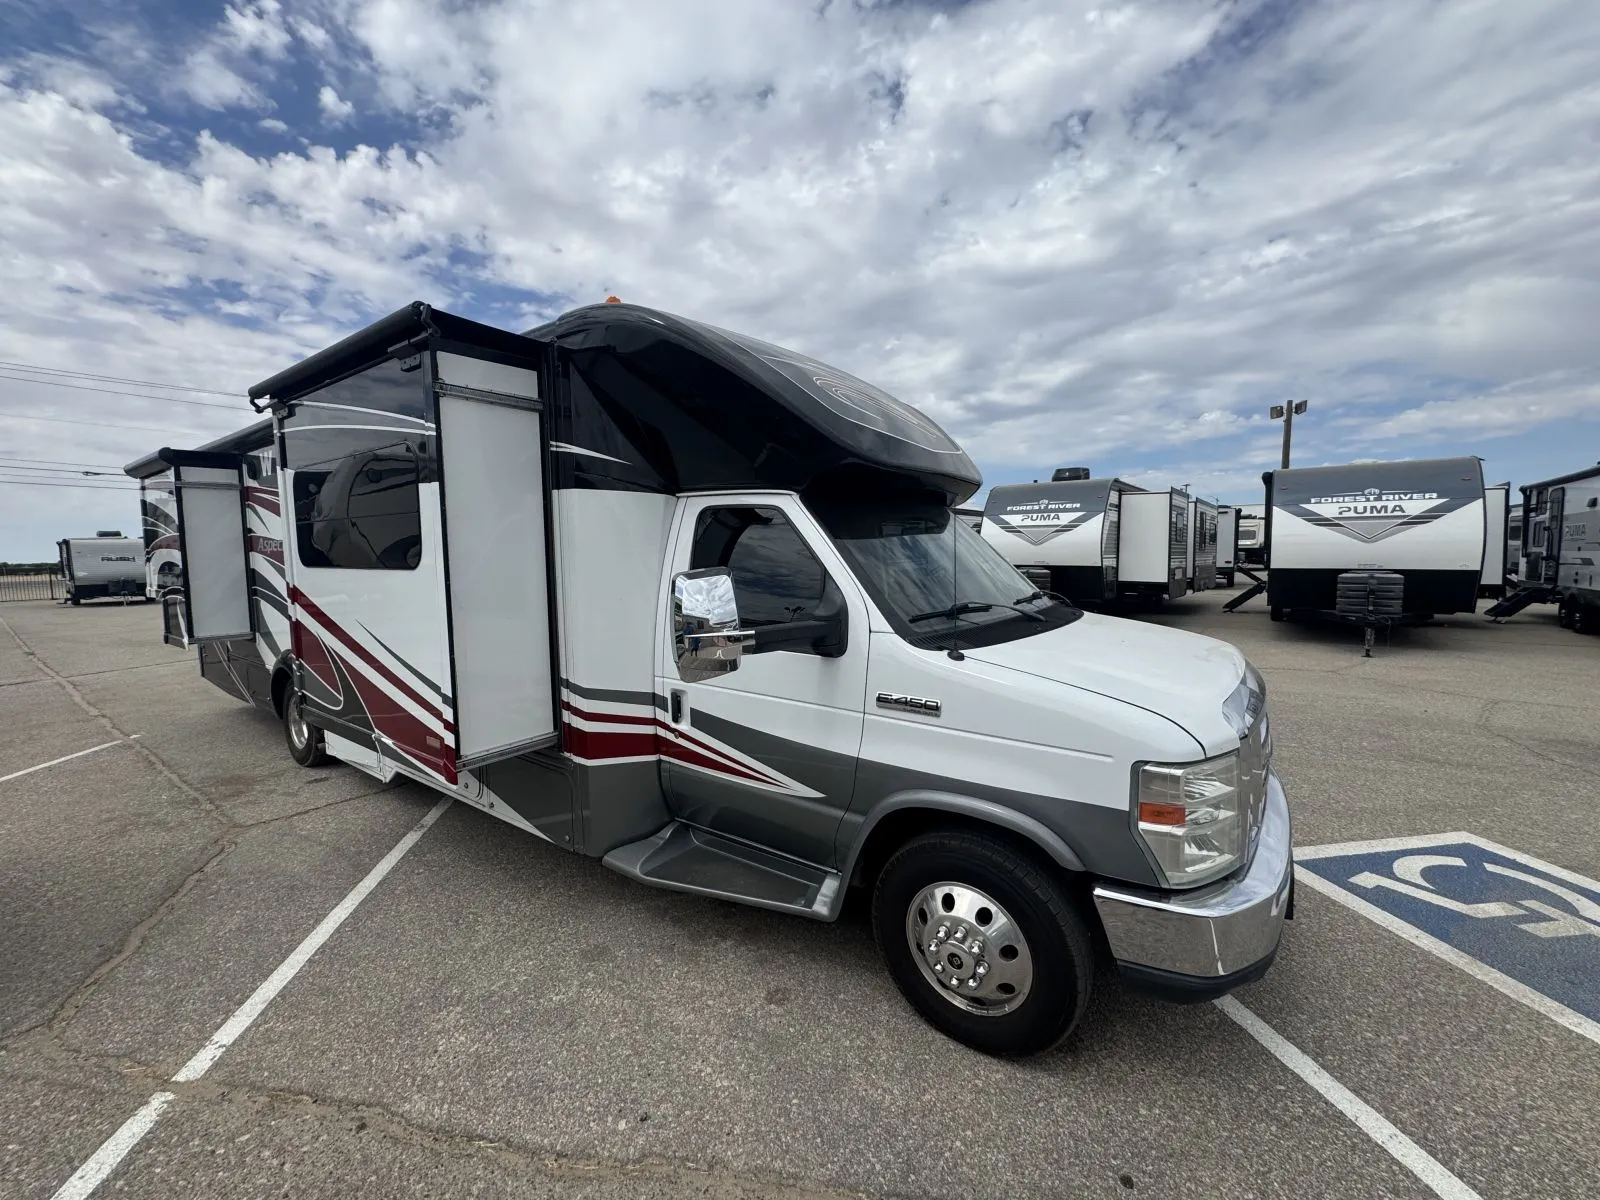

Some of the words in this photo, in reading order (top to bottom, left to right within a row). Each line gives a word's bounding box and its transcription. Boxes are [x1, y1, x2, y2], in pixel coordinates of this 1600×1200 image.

[1310, 496, 1378, 504] FOREST
[1382, 492, 1438, 501] RIVER
[1338, 504, 1406, 516] PUMA
[1021, 513, 1060, 521] PUMA
